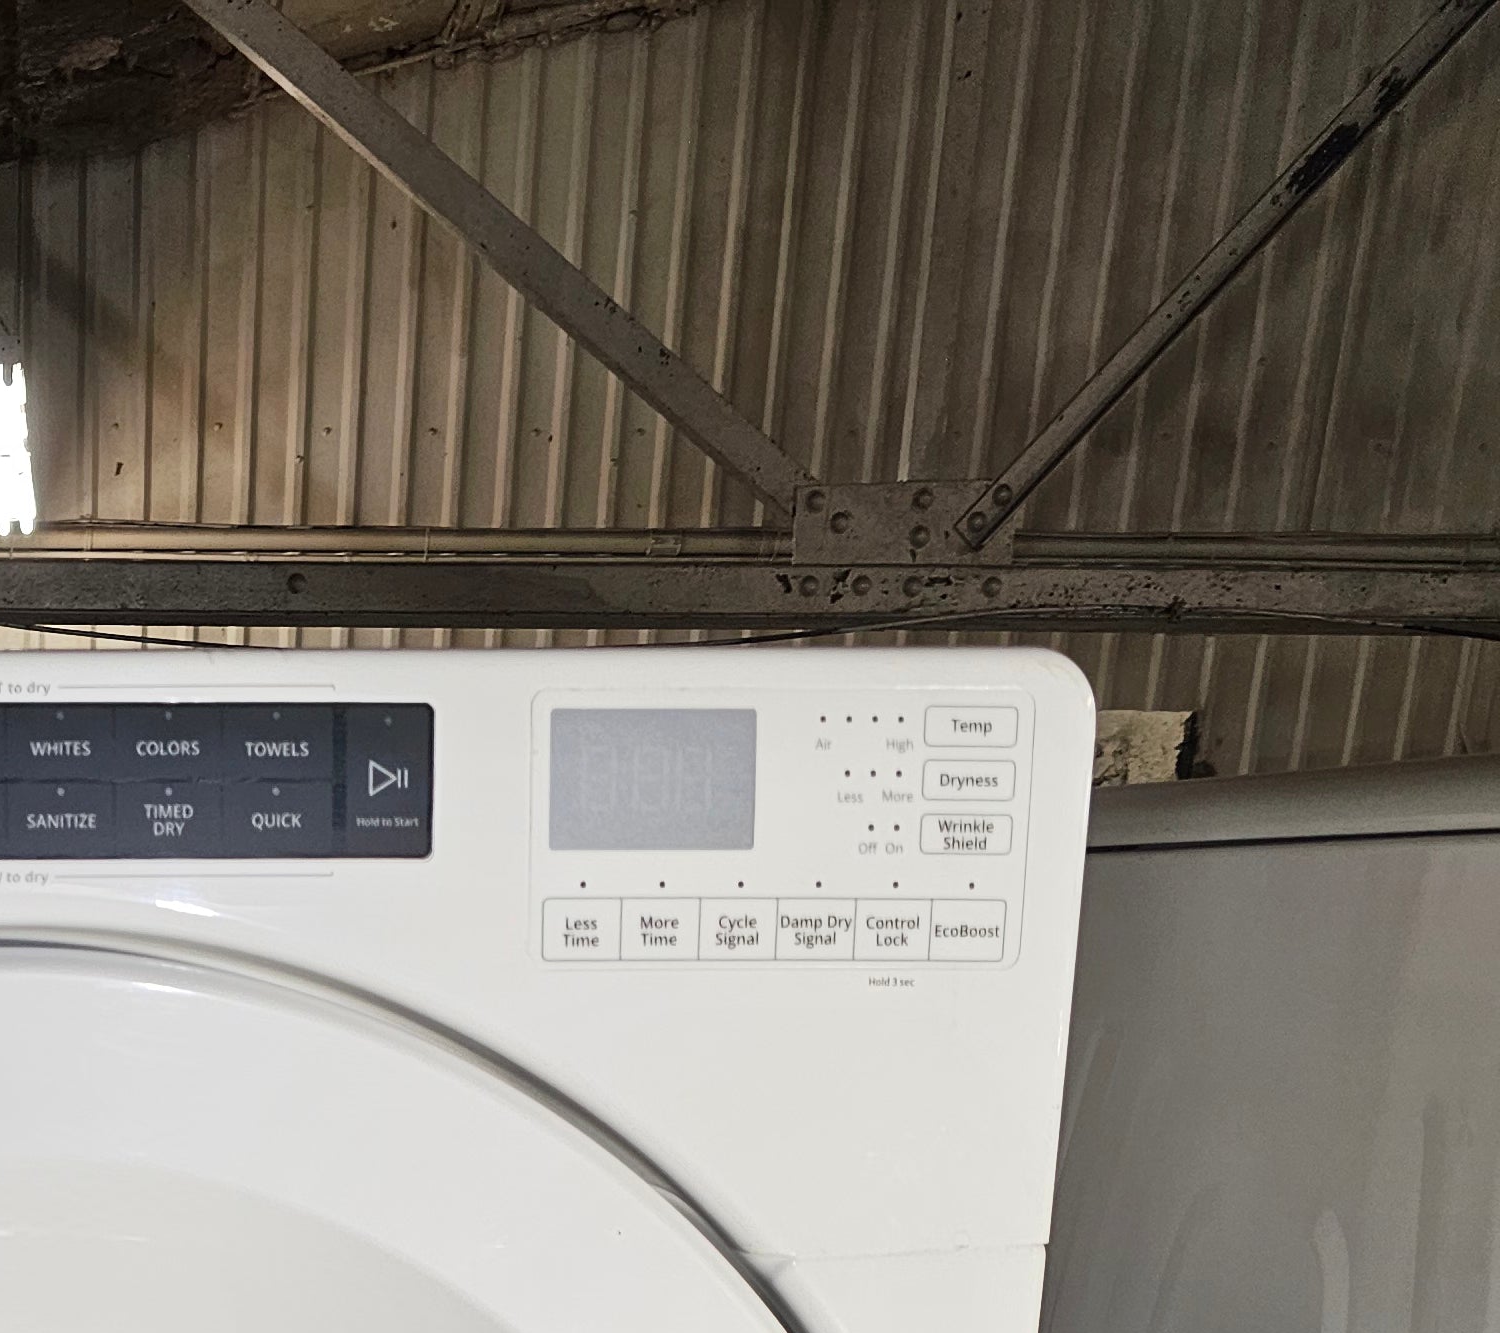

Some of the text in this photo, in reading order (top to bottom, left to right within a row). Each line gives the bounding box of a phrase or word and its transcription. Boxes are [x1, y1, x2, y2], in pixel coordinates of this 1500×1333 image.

[7, 682, 23, 695] to
[26, 681, 52, 697] dry
[951, 718, 993, 737] Temp
[30, 741, 91, 757] WHITES
[135, 740, 200, 757] COLORS
[245, 741, 310, 758] TOWELS
[815, 738, 832, 751] Air
[885, 738, 914, 754] High
[939, 773, 999, 791] Dryness
[837, 790, 864, 804] Less
[881, 790, 914, 804] More
[144, 804, 194, 820] TIMED
[26, 814, 97, 830] SANITIZE
[153, 821, 185, 837] DRY
[251, 813, 302, 831] QUICK
[356, 816, 380, 828] Hold
[394, 816, 419, 828] Start
[938, 819, 995, 834] Wrinkle
[858, 841, 878, 855] Off
[885, 842, 904, 855] On
[943, 836, 988, 851] Shield
[6, 872, 21, 884] to
[24, 870, 50, 887] dry
[565, 916, 598, 931] Less
[639, 915, 680, 930] More
[718, 915, 758, 932] Cycle
[780, 915, 852, 932] Damp Dry
[865, 916, 920, 930] Control
[934, 924, 1000, 938] EcoBoost
[563, 933, 600, 948] Time
[641, 932, 678, 947] Time
[715, 932, 759, 950] Signal
[794, 932, 837, 949] Signal
[875, 932, 909, 947] Lock
[868, 975, 890, 987] Hold
[899, 979, 916, 988] sec
